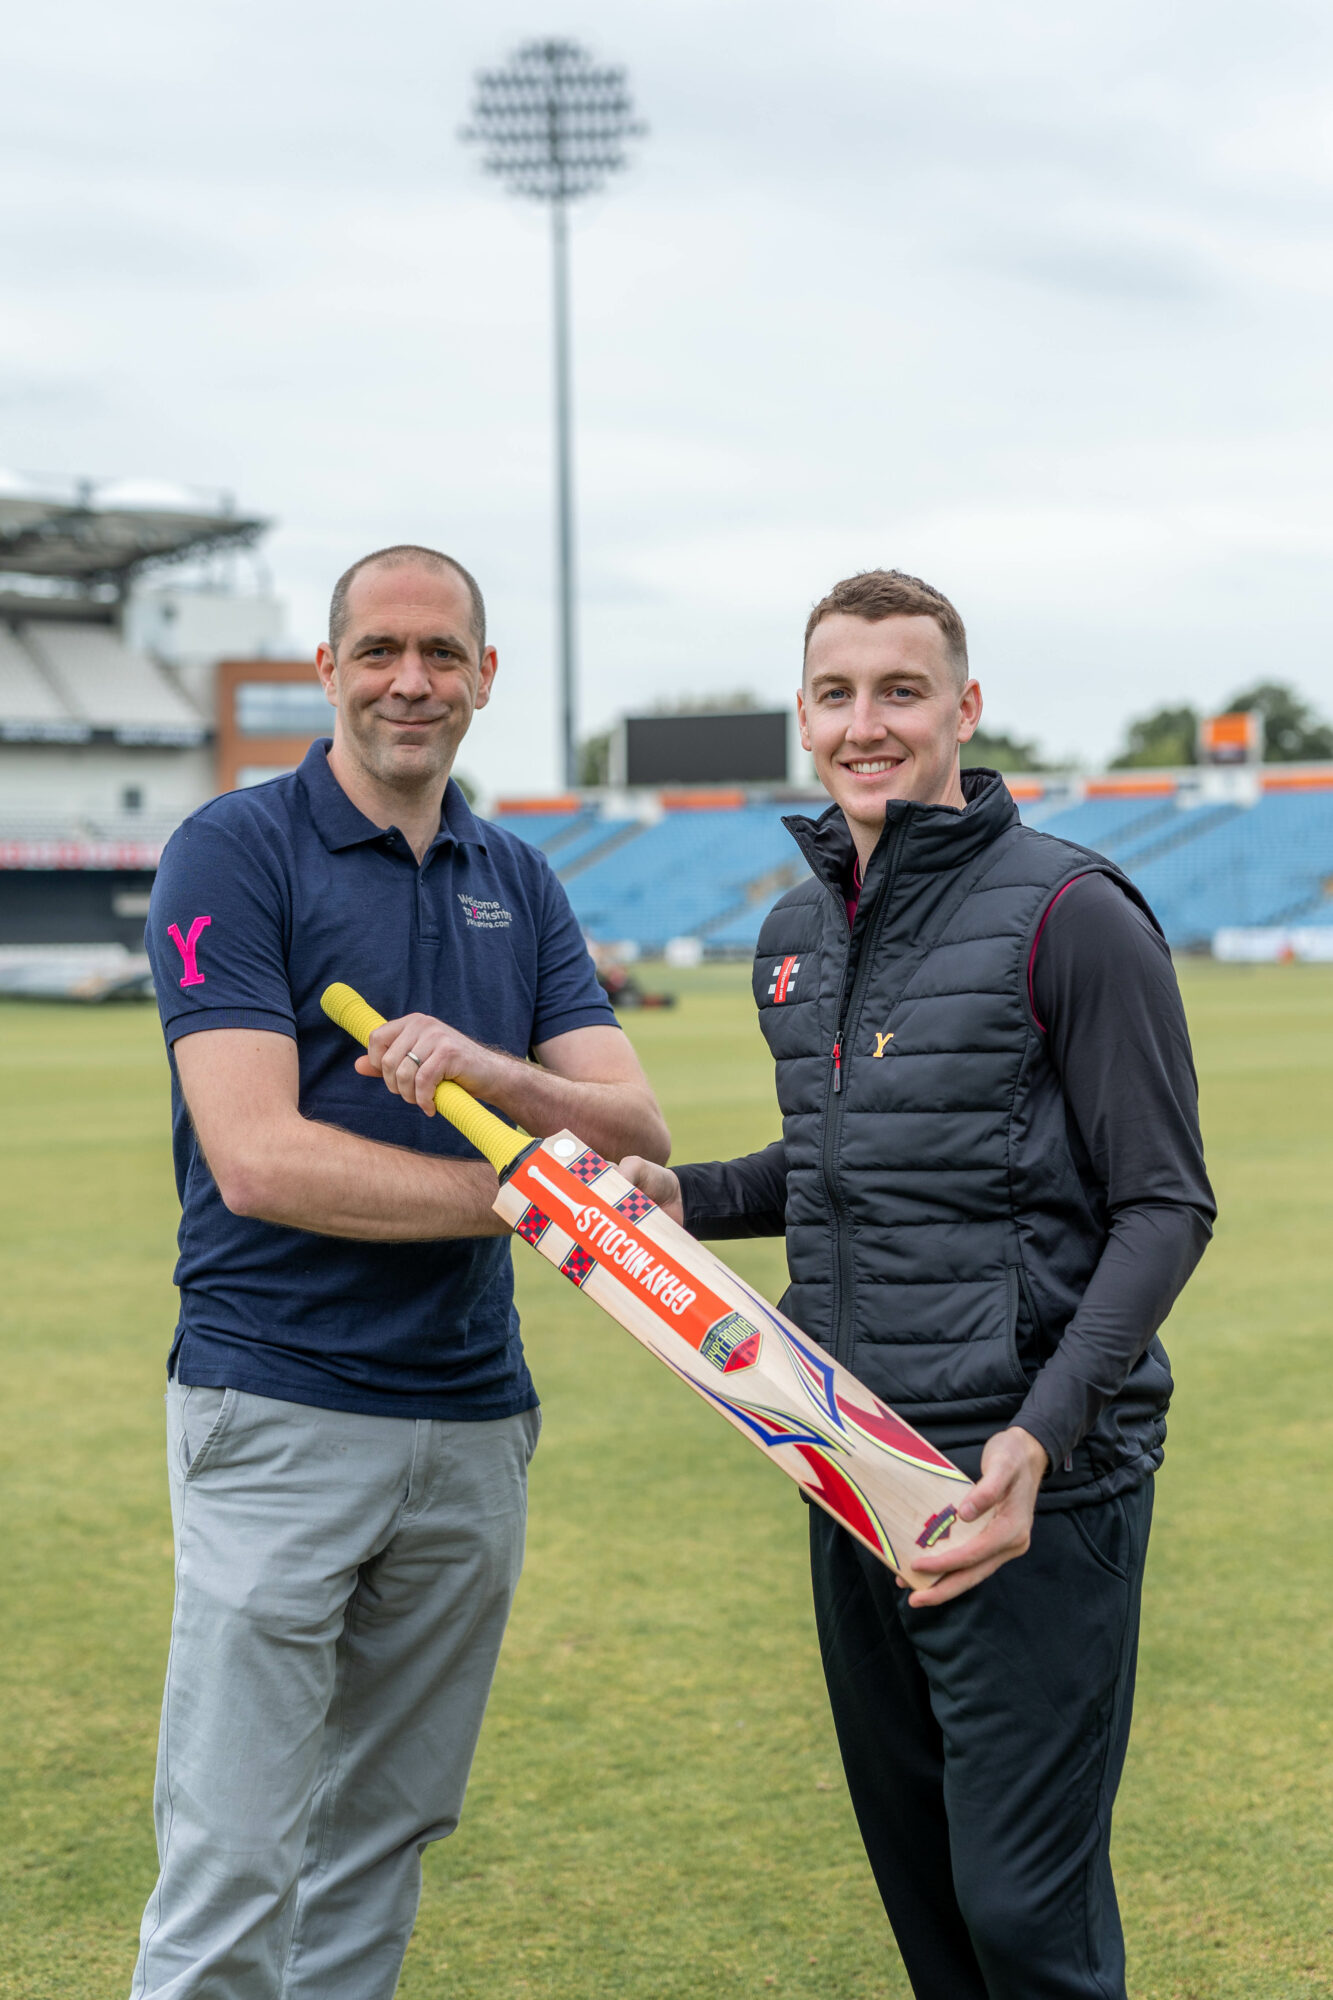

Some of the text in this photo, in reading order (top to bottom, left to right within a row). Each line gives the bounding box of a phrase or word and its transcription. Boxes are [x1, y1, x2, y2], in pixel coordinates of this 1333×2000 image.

[463, 906, 473, 917] to
[167, 915, 212, 988] Y
[872, 1032, 895, 1058] Y
[576, 1206, 697, 1316] GRAY-NICOLLS
